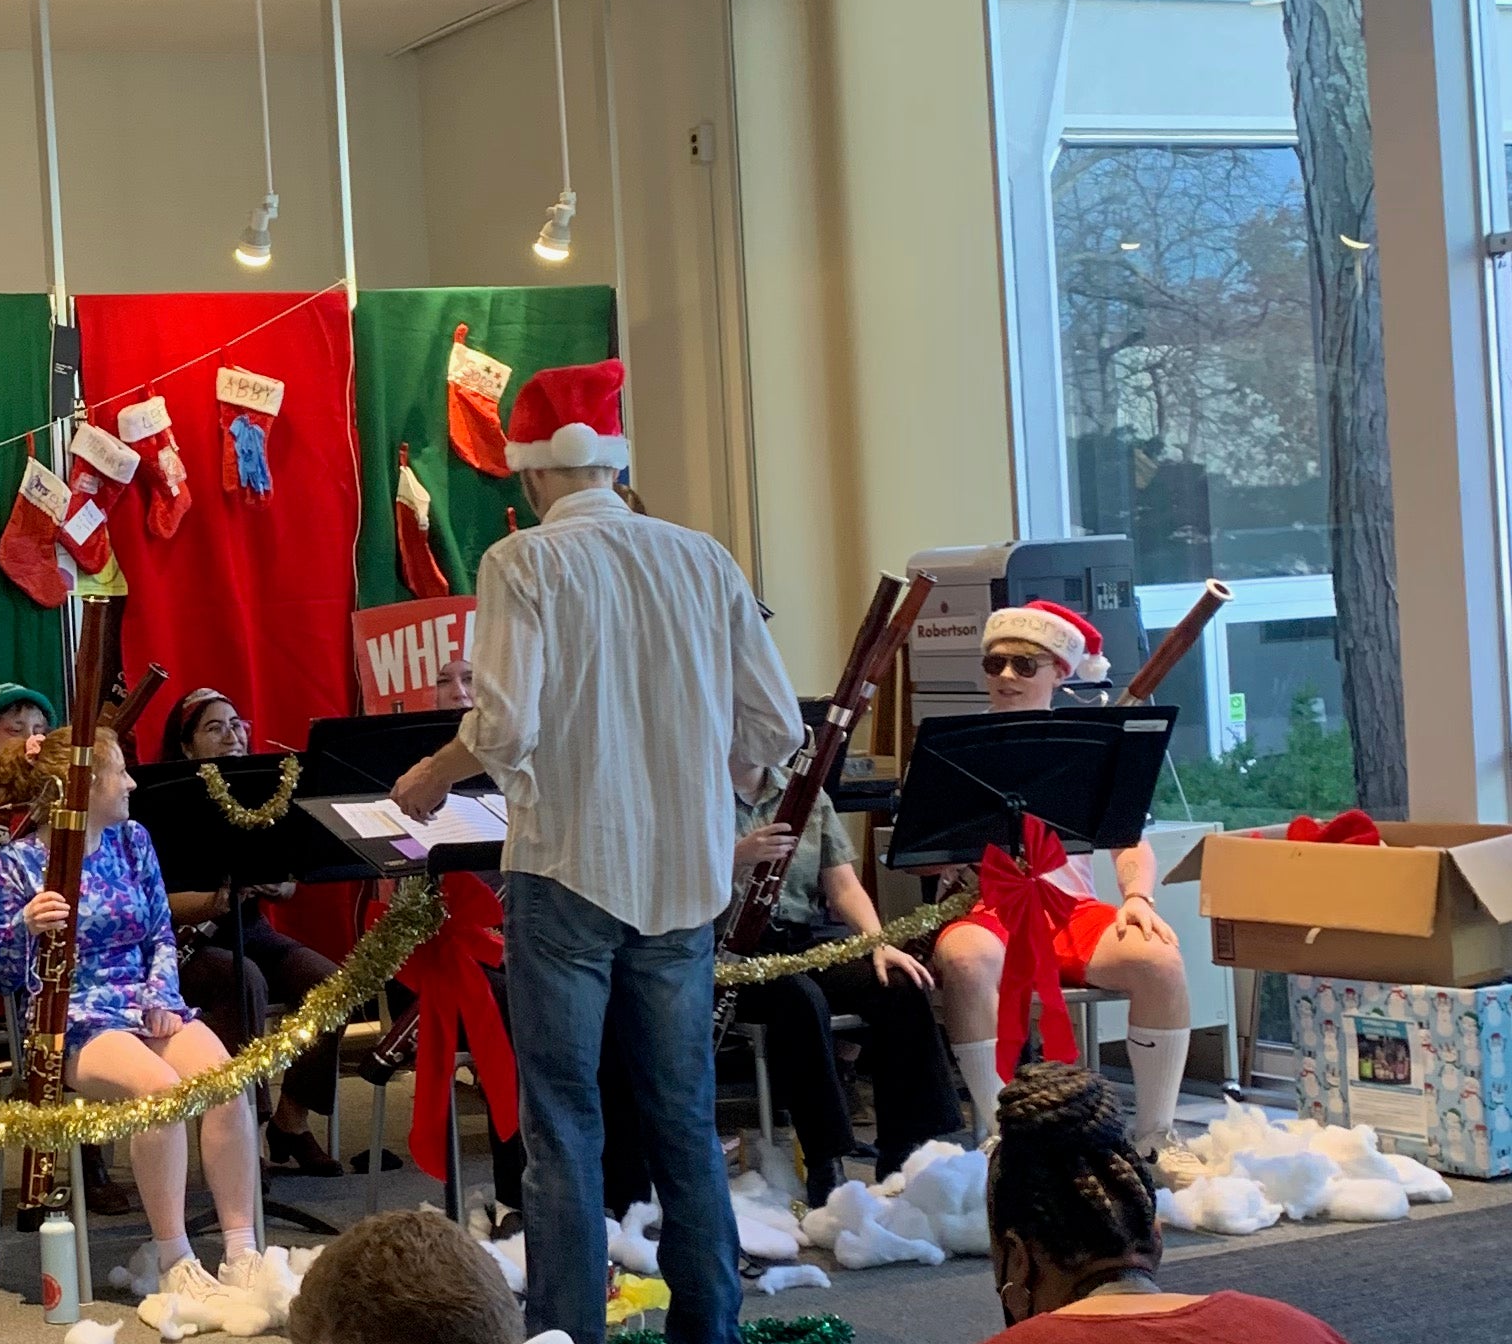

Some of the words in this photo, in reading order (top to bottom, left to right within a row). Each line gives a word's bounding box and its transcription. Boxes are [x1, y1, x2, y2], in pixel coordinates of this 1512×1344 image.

[221, 376, 275, 406] ABBY
[917, 624, 978, 639] Robertson
[366, 610, 478, 697] WHE
